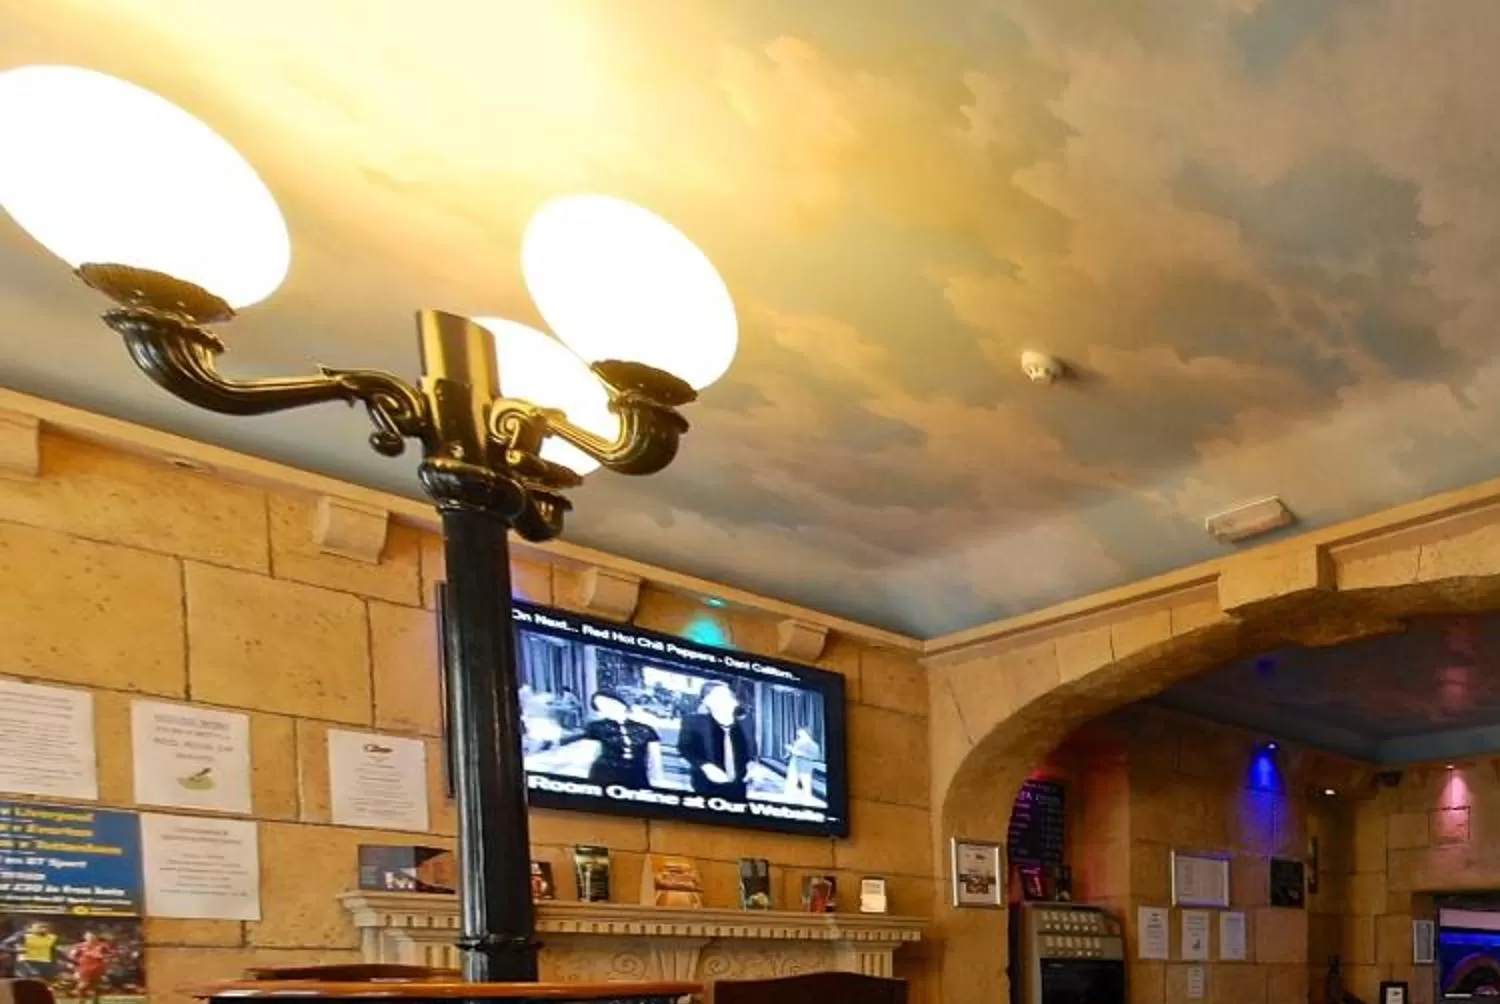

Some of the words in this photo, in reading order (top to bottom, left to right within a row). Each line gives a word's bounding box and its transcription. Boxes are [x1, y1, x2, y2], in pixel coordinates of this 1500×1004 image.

[582, 623, 610, 639] Red
[613, 631, 635, 645] Hot
[666, 643, 715, 663] Peppers
[528, 775, 602, 796] Room
[606, 785, 680, 805] Online
[683, 795, 705, 809] at
[707, 797, 747, 813] Our
[749, 802, 826, 823] Website
